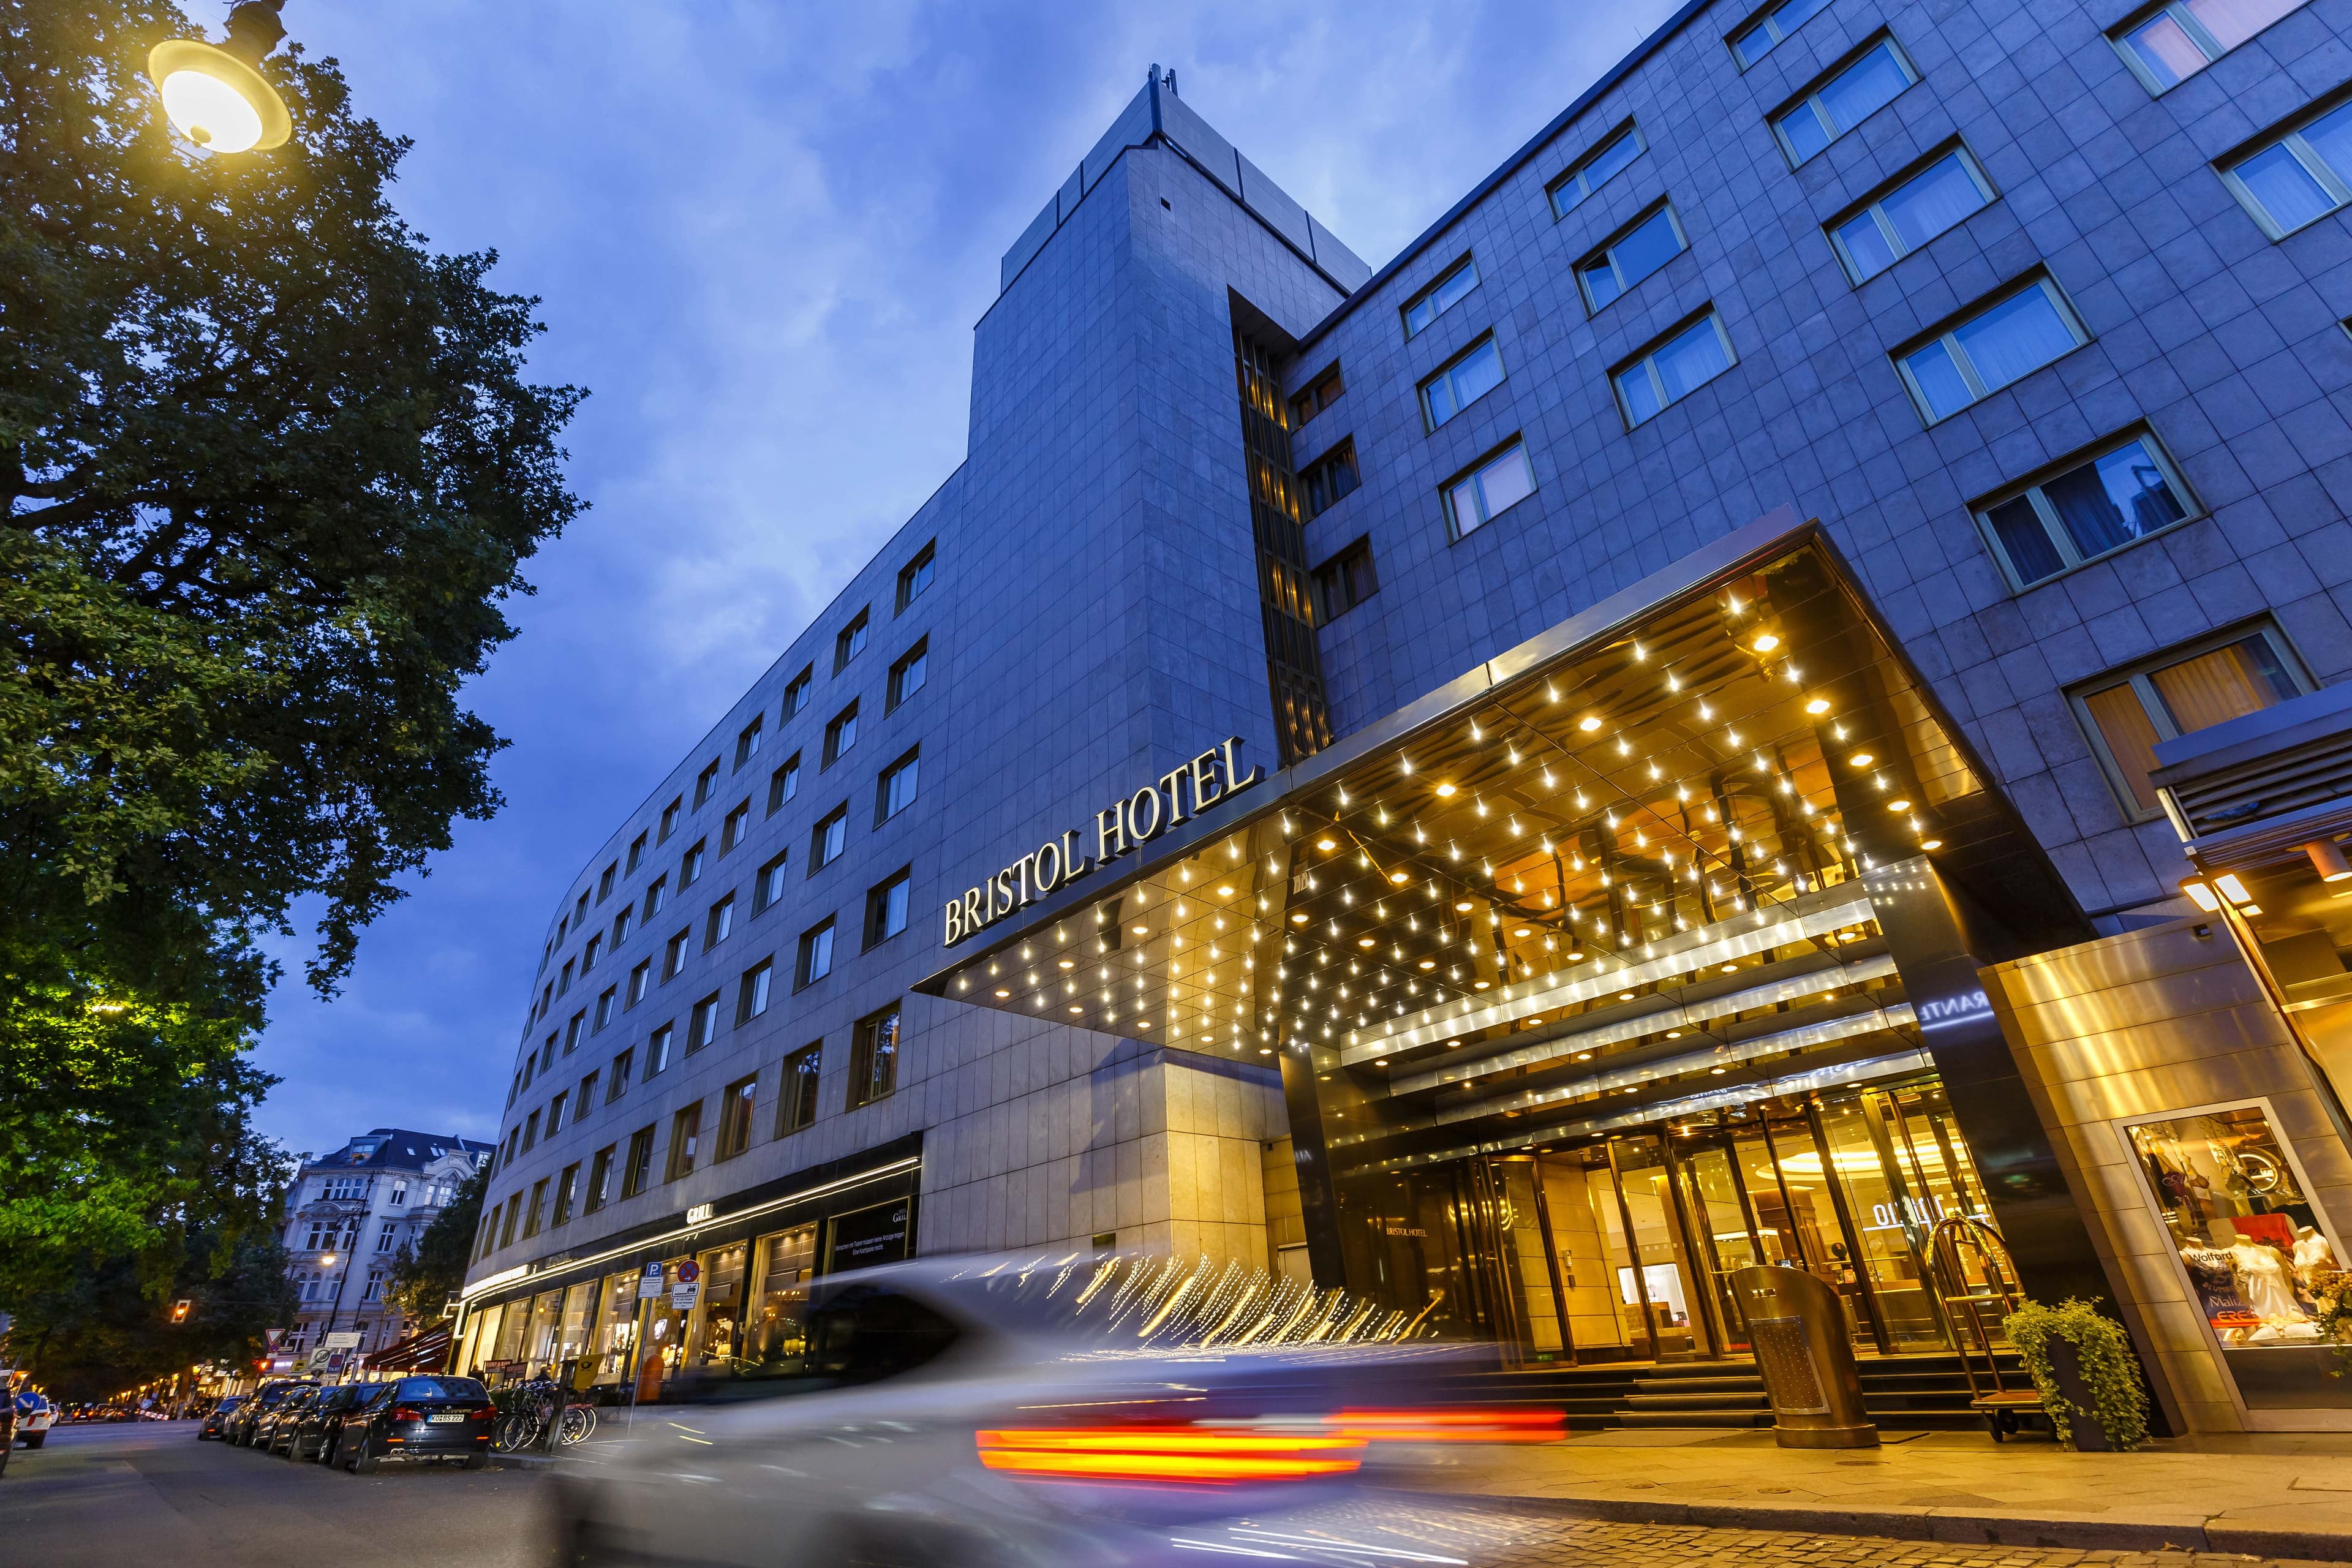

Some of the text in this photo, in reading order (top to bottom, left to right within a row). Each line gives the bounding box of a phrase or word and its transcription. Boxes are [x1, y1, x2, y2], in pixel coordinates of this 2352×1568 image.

[943, 736, 1262, 948] BRISTOL HOTEL
[687, 1204, 713, 1224] GRILL
[1387, 1227, 1427, 1237] BRISTOL HOTEL
[2190, 1251, 2233, 1262] Wolford
[650, 1264, 658, 1276] P
[2217, 1308, 2259, 1322] ERES
